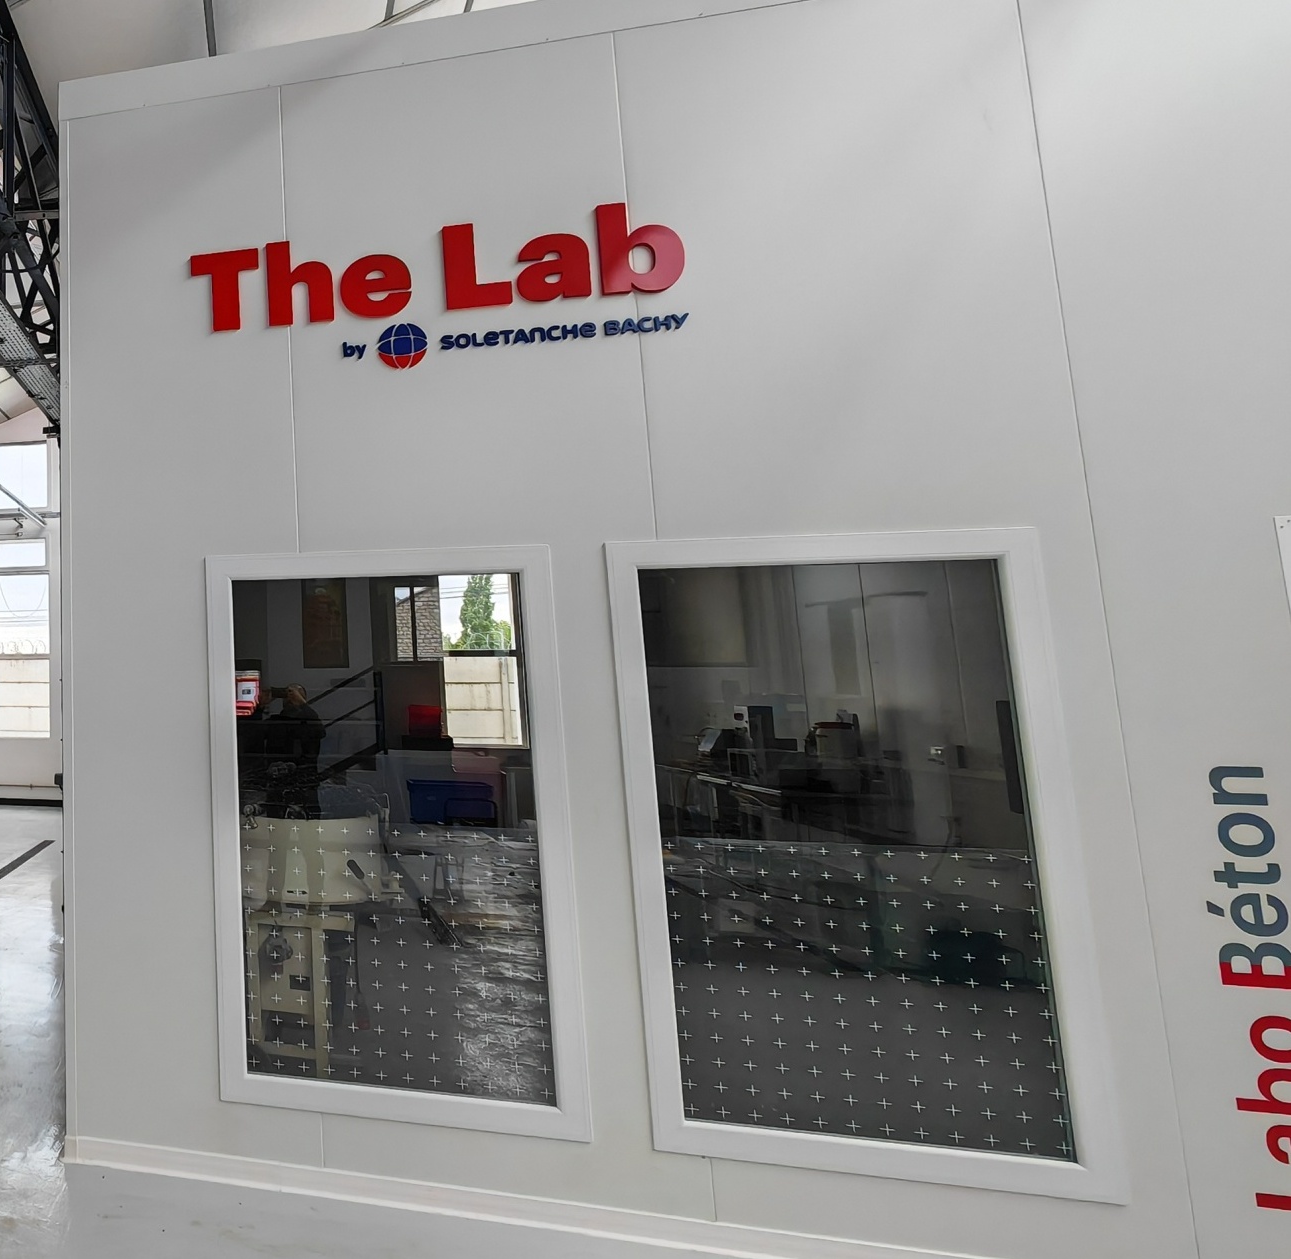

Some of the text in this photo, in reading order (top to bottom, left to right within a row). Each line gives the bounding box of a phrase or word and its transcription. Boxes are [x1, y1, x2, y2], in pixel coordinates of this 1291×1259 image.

[189, 202, 686, 332] The Lab
[341, 341, 367, 360] by
[603, 312, 689, 337] BACHY
[1206, 765, 1291, 990] Béton
